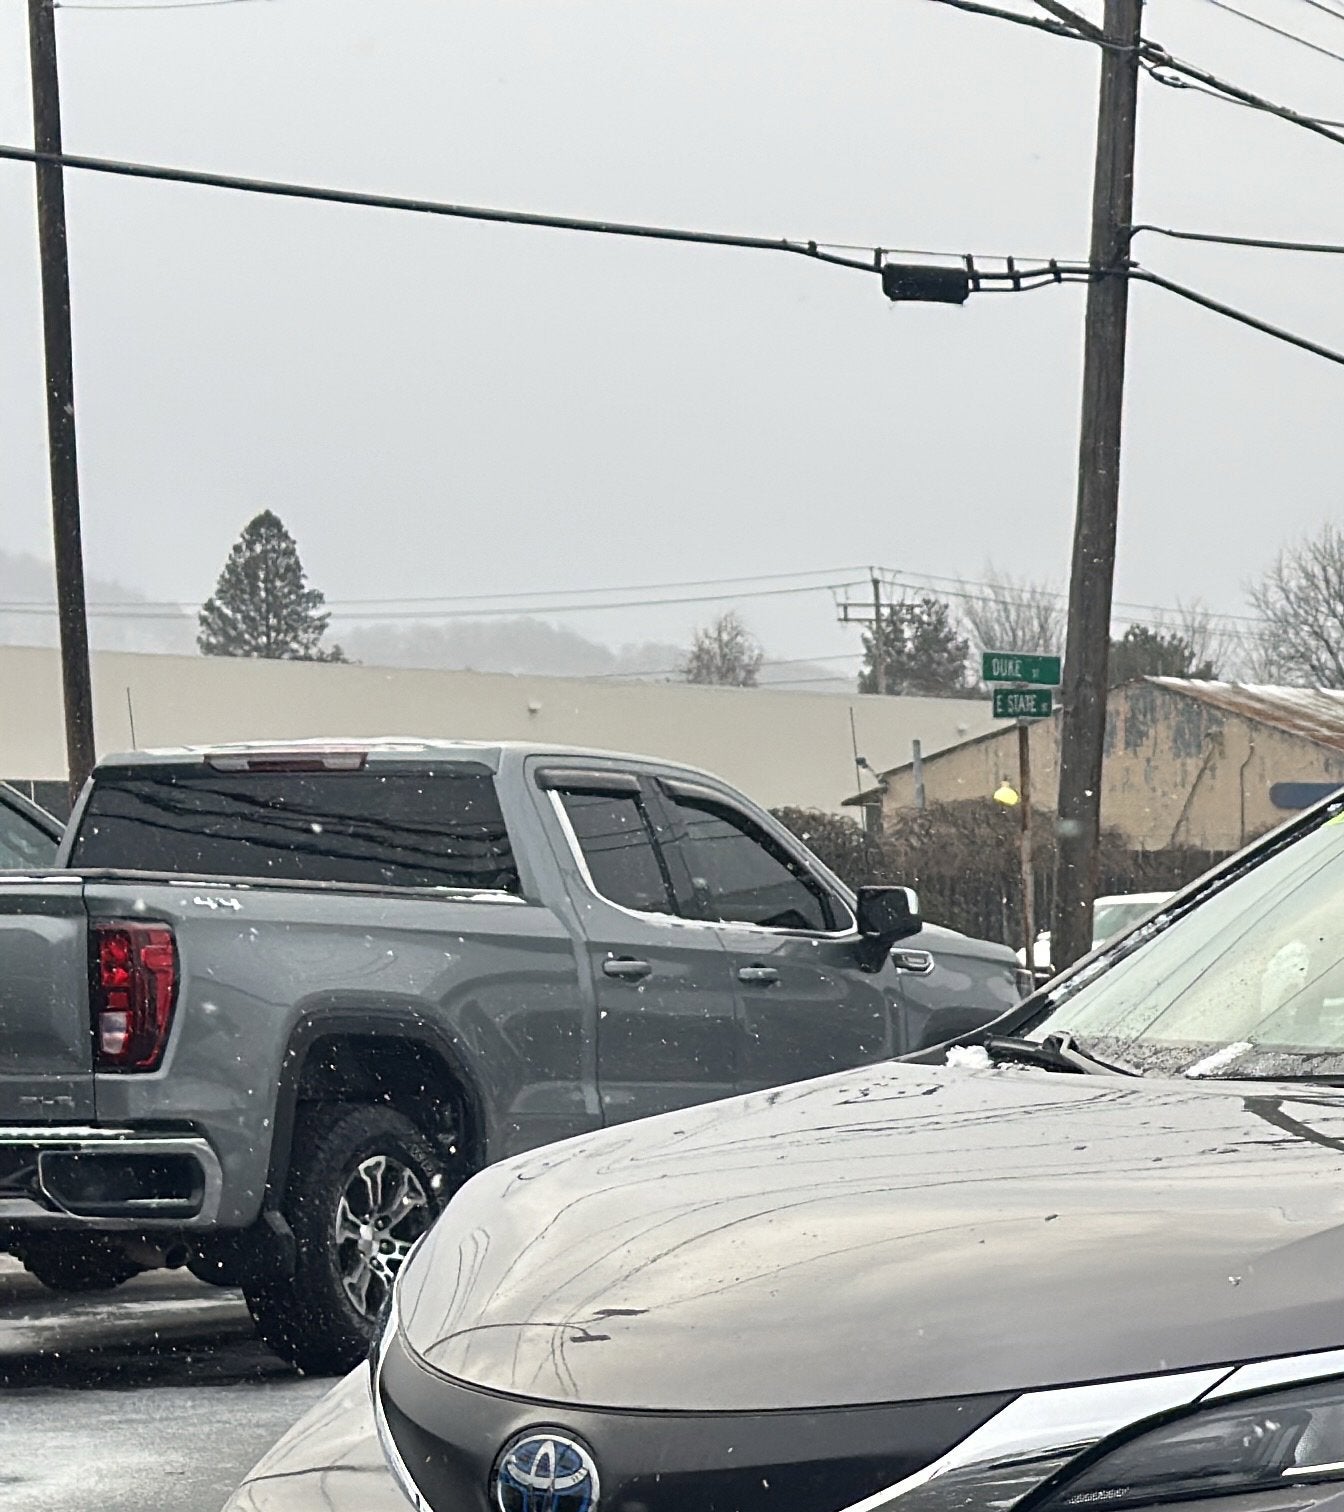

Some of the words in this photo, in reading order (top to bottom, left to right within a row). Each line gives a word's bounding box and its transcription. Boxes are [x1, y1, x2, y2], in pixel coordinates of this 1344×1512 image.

[991, 658, 1022, 677] DUKE
[996, 694, 1003, 712] E
[1007, 694, 1037, 714] STATE
